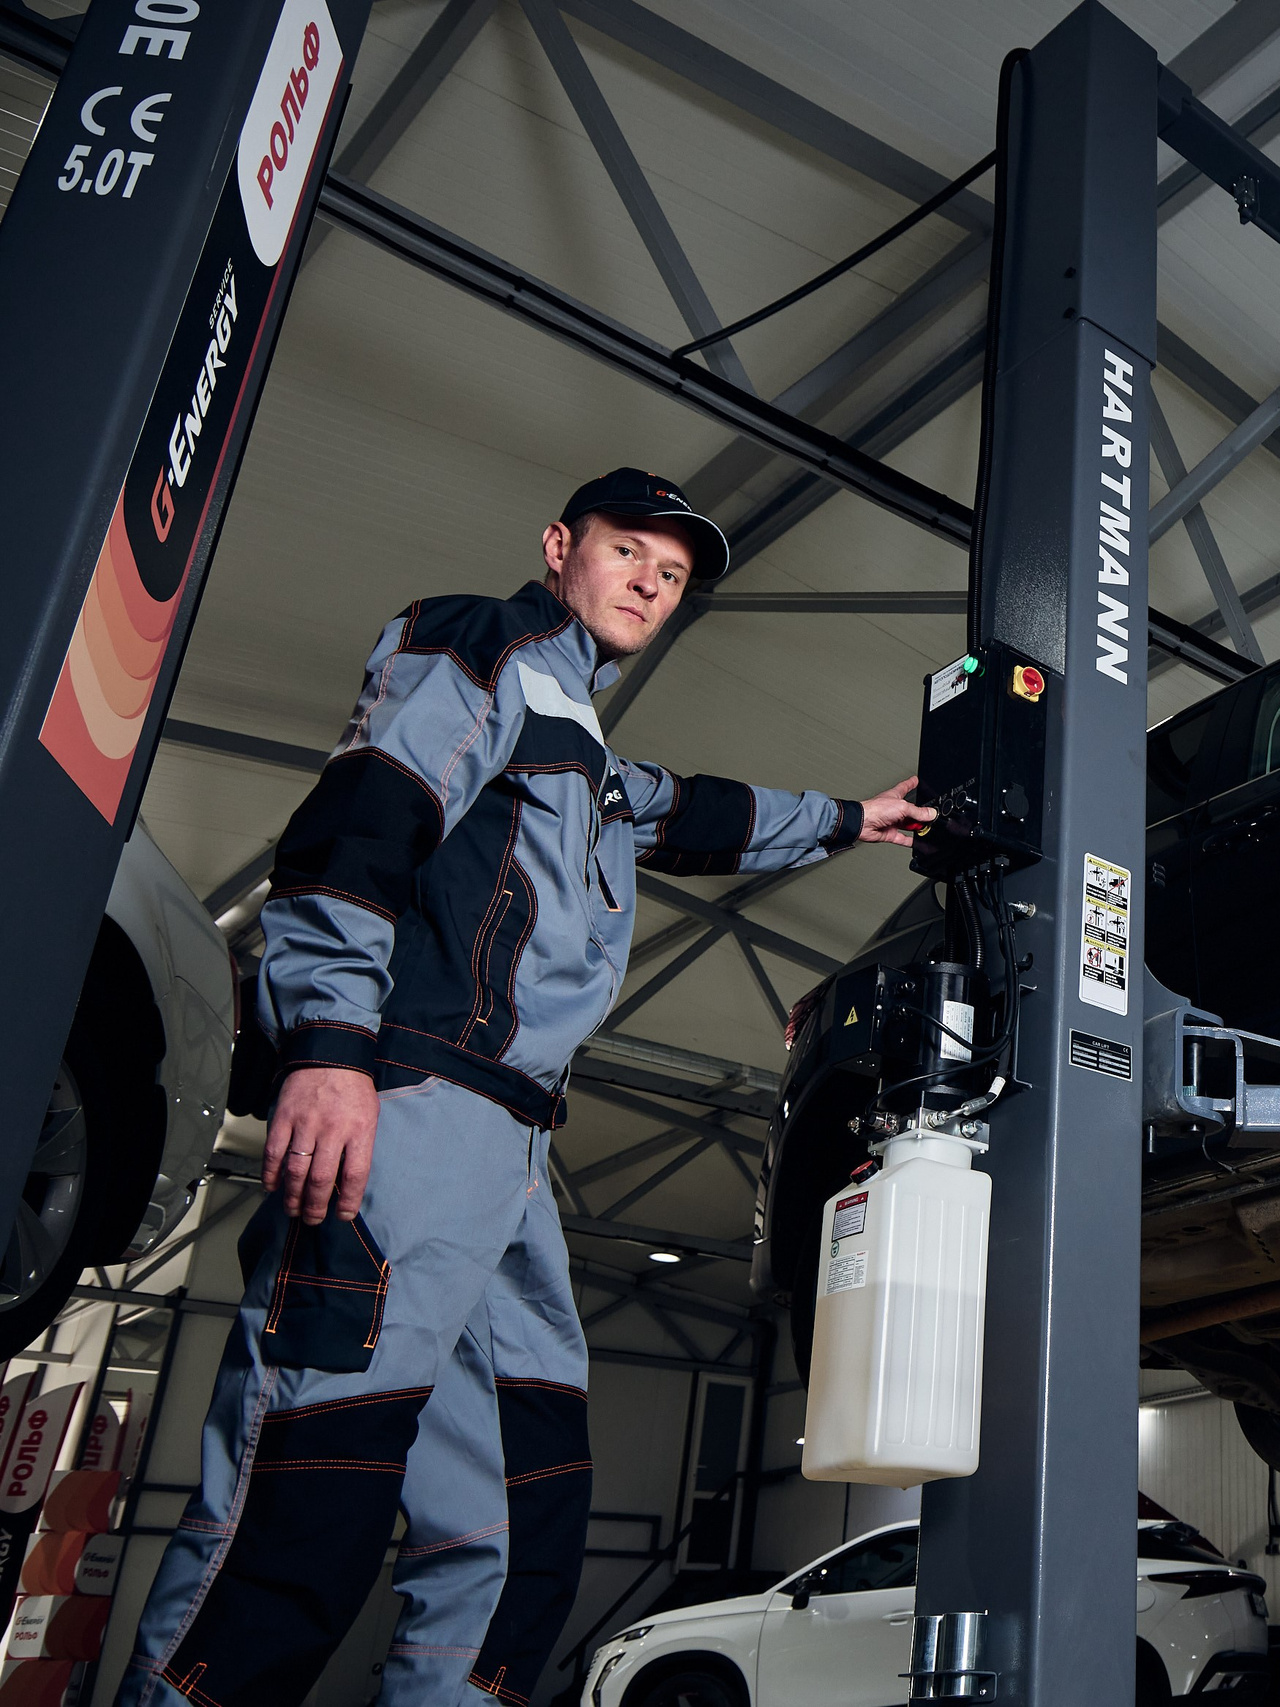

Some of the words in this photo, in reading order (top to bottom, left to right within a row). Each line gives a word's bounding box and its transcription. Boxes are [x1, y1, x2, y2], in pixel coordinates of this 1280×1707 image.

[256, 22, 320, 210] РОЛЬФ
[58, 144, 155, 199] 5.0T
[209, 257, 234, 330] SERVICE
[1095, 348, 1134, 686] HARTMANN
[6, 1409, 49, 1497] РОЛЬФ
